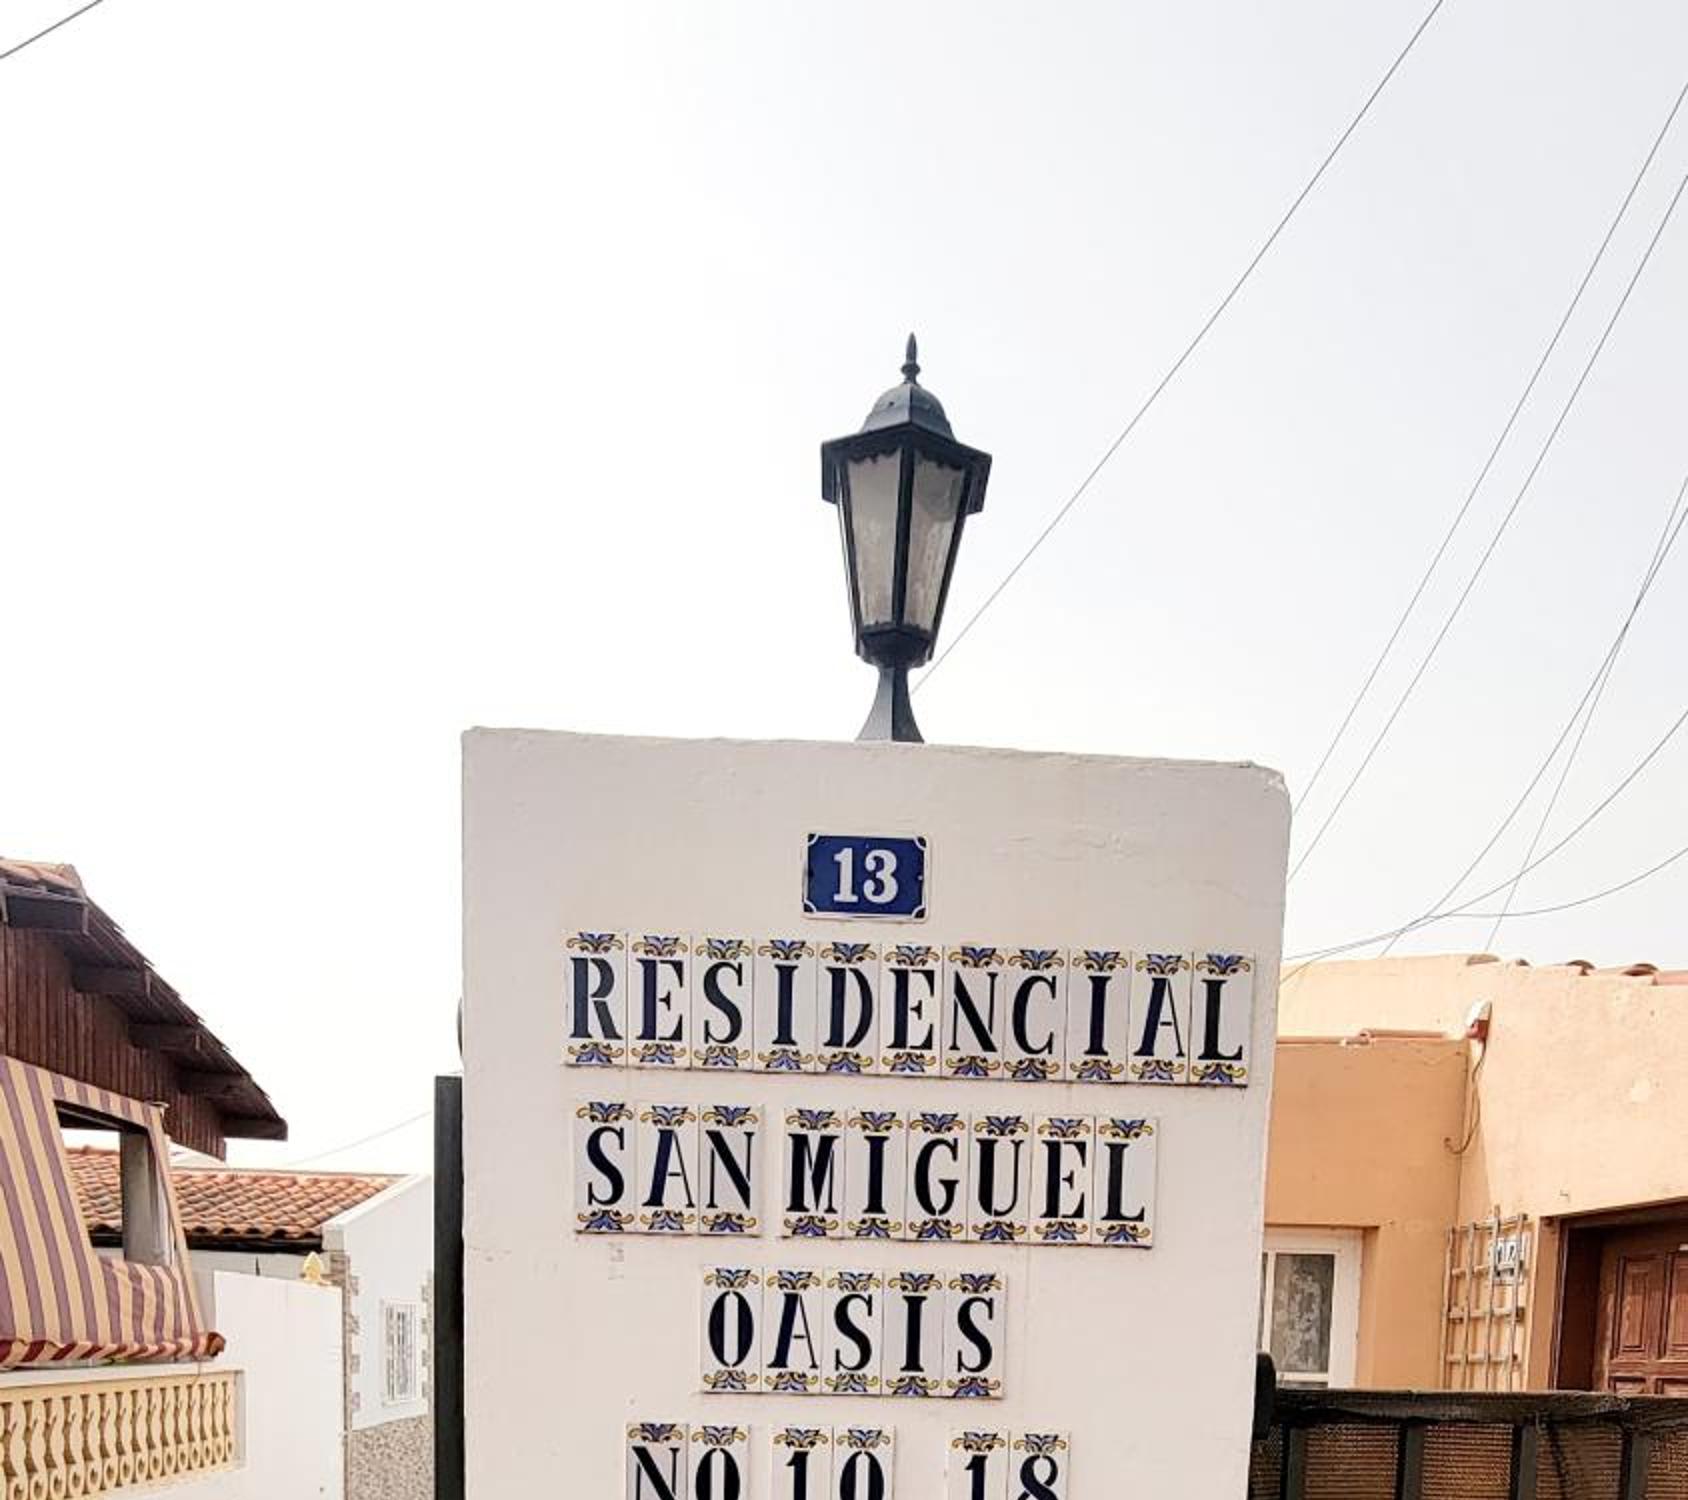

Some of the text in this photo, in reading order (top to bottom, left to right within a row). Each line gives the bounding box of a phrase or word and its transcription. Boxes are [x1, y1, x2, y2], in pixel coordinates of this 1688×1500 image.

[833, 847, 898, 904] 13
[570, 958, 1242, 1061] RESIDENCIAL
[587, 1126, 1144, 1221] SAN MIGUEL
[709, 1291, 993, 1372] OASIS
